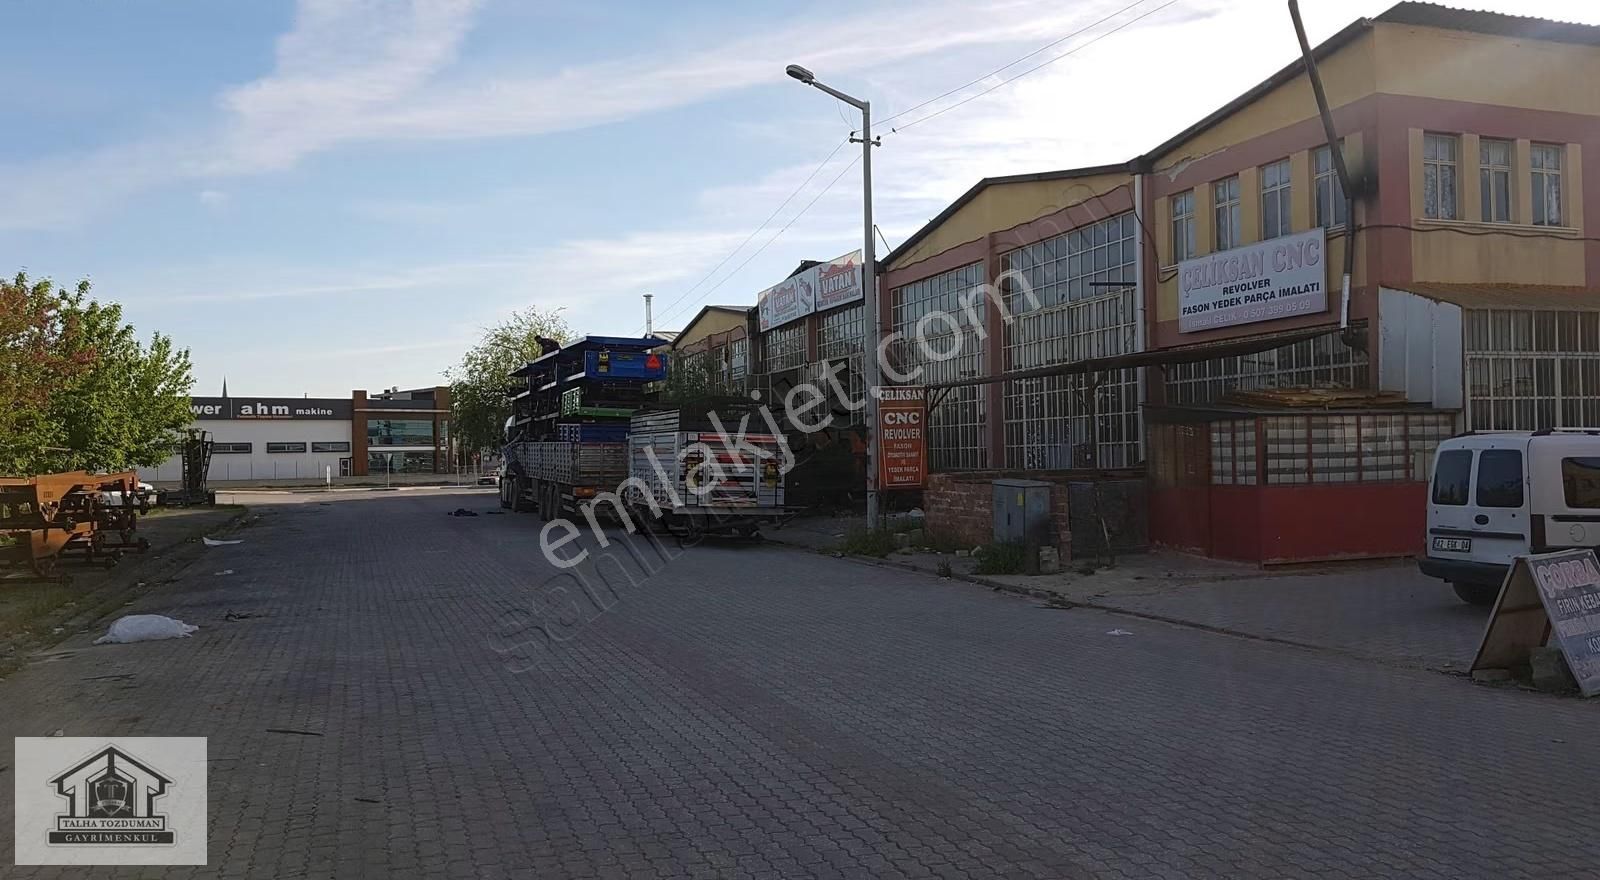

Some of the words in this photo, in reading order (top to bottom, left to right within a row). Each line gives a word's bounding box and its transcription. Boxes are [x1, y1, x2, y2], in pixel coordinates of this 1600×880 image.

[1272, 238, 1320, 272] CNC
[822, 271, 852, 294] VATAN
[1223, 278, 1271, 296] REVOLVER
[1182, 303, 1210, 316] FASON
[1212, 297, 1242, 310] YEDEK
[1244, 291, 1276, 307] PARÇA
[1279, 282, 1320, 298] İMALATI
[190, 404, 222, 415] wer
[296, 407, 333, 416] makine
[884, 412, 920, 425] CNC
[884, 428, 921, 440] REVOLVER
[1537, 558, 1600, 598] ÇORBA
[1557, 597, 1580, 616] FIRIN
